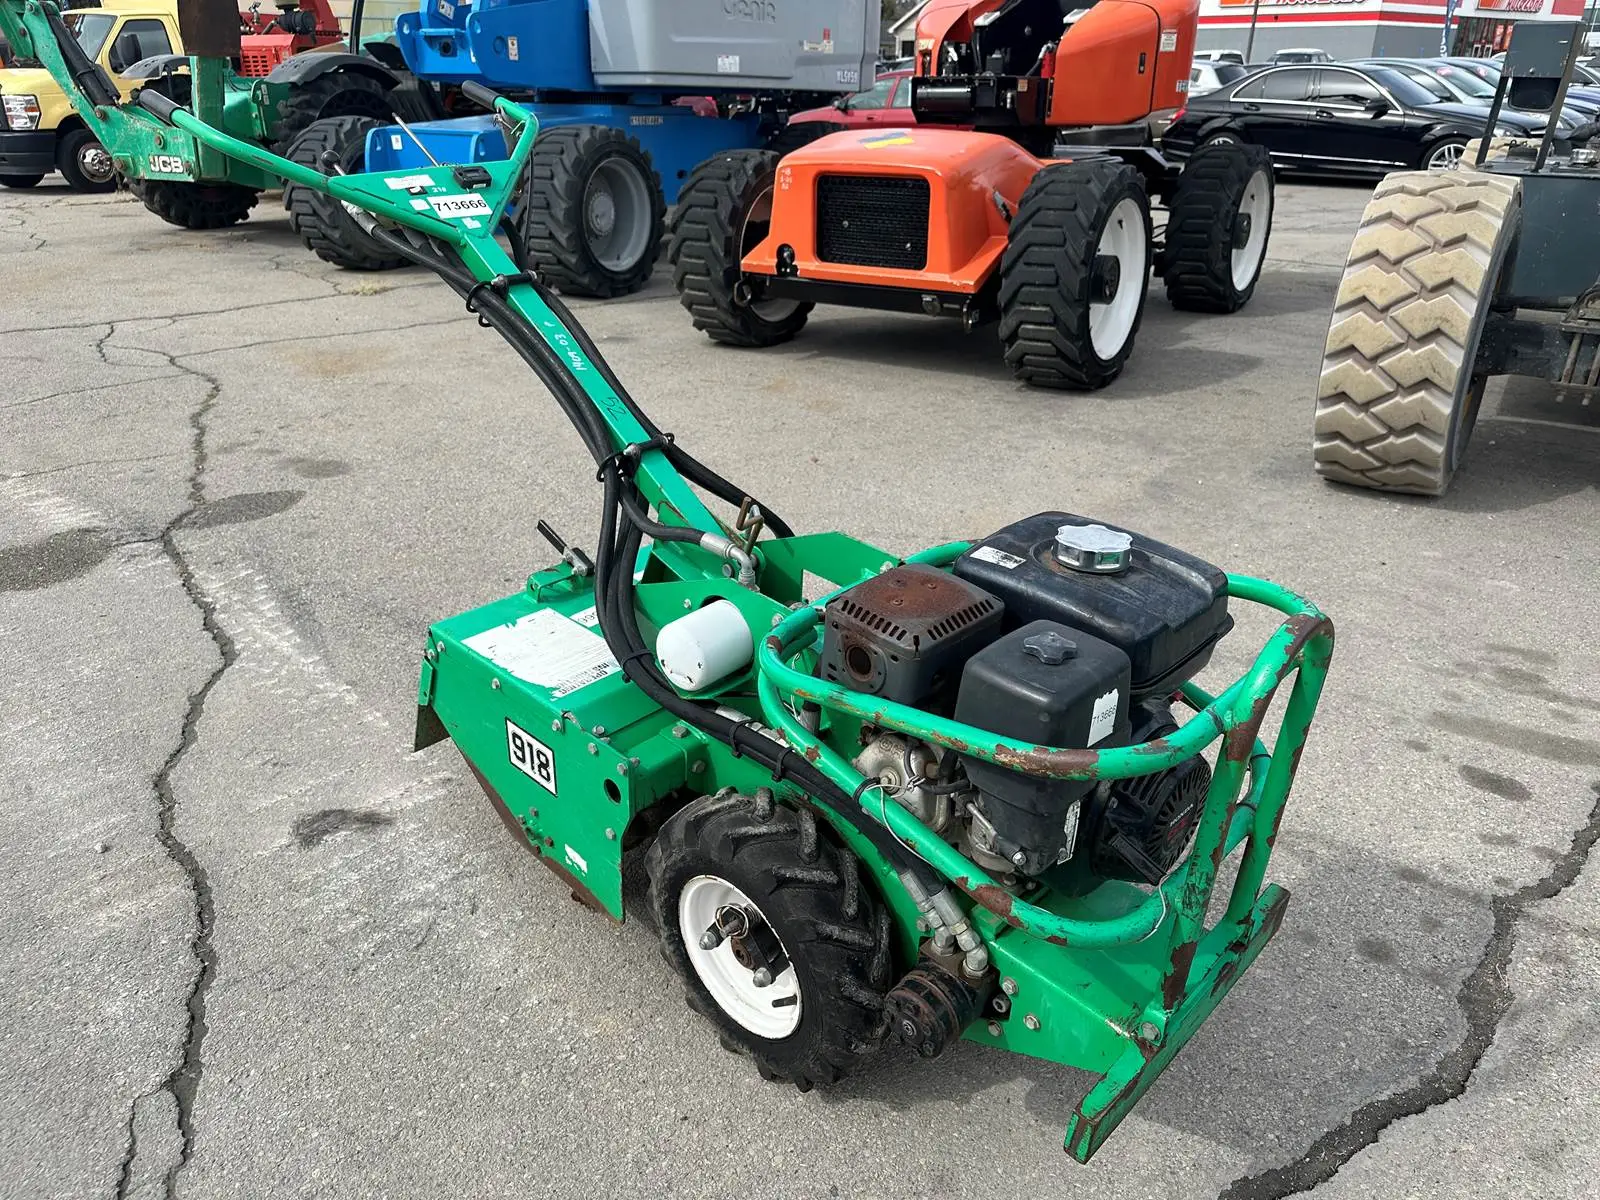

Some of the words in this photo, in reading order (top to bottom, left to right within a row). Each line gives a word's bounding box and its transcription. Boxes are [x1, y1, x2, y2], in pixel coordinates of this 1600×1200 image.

[149, 155, 184, 173] JCB
[432, 199, 487, 212] 713666
[511, 731, 552, 784] 918
